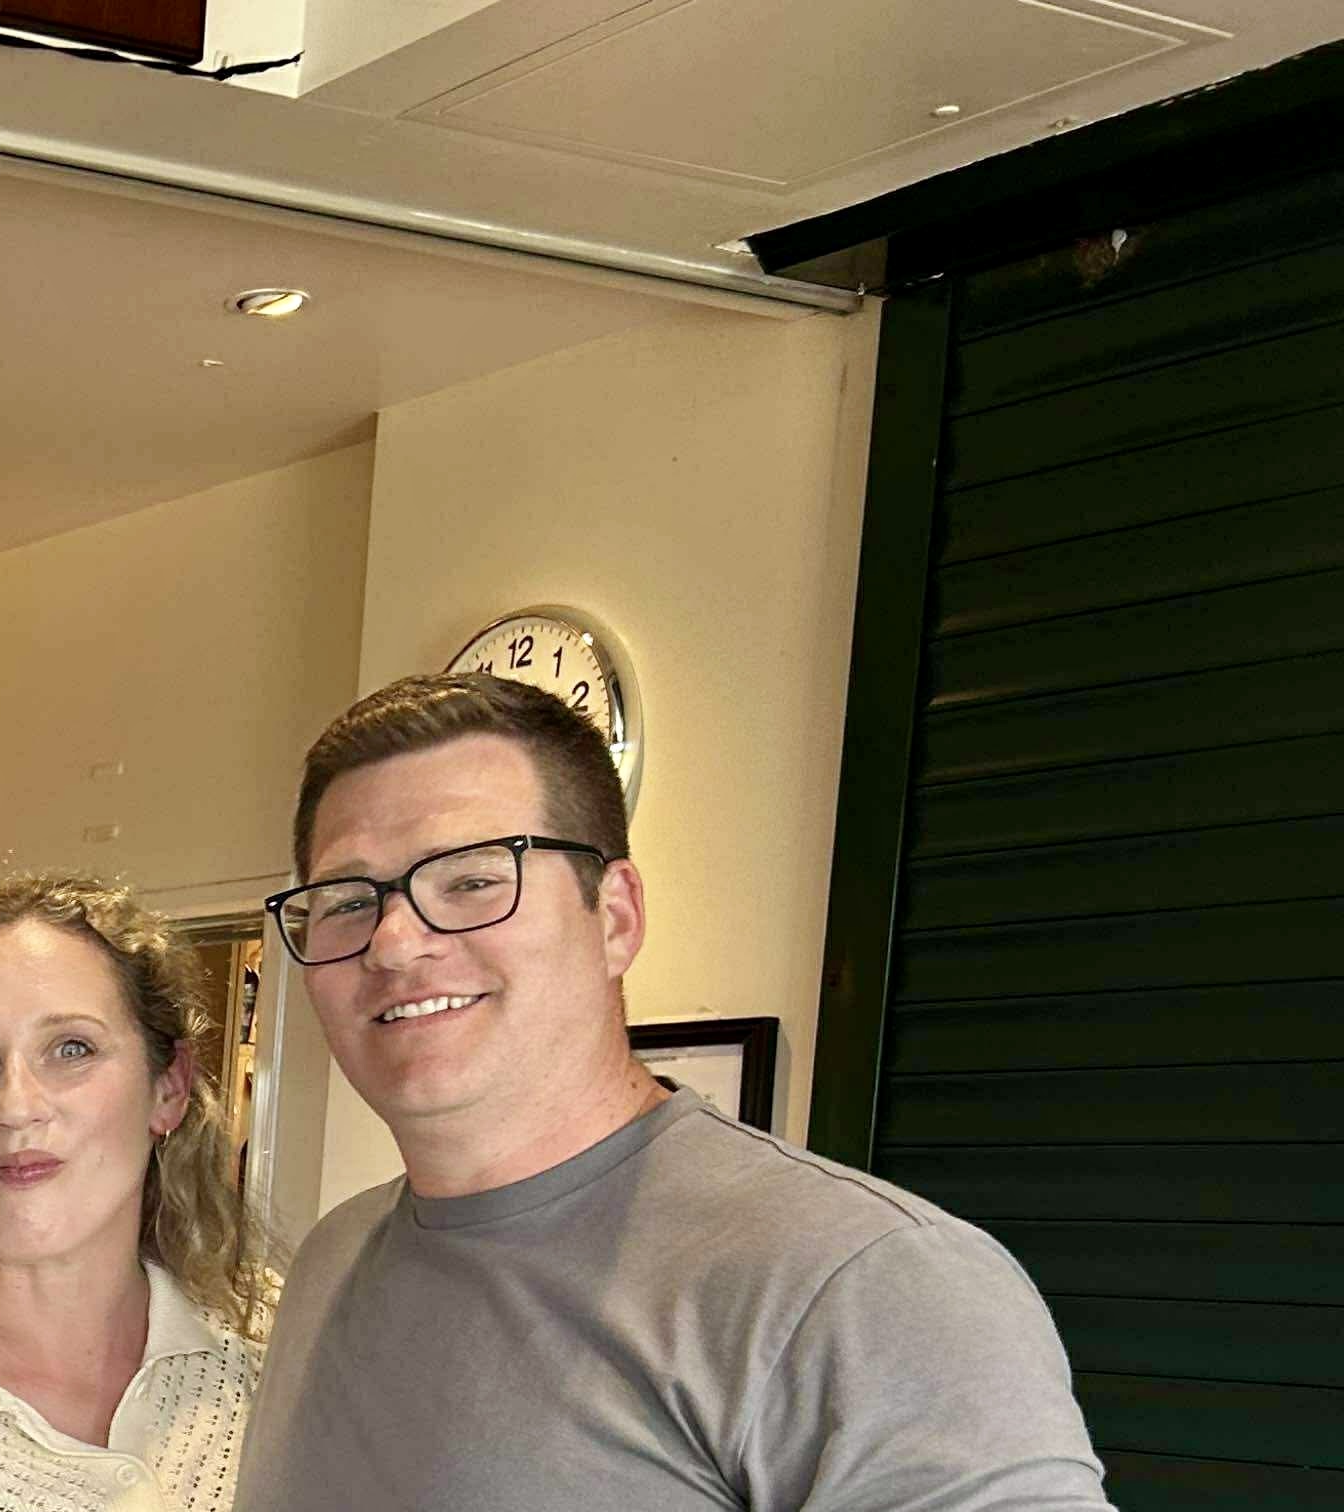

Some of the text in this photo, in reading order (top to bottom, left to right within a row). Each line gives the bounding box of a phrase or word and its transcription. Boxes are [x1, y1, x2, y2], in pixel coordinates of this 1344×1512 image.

[508, 635, 534, 669] 12
[553, 646, 563, 678] 1
[572, 680, 590, 711] 2
